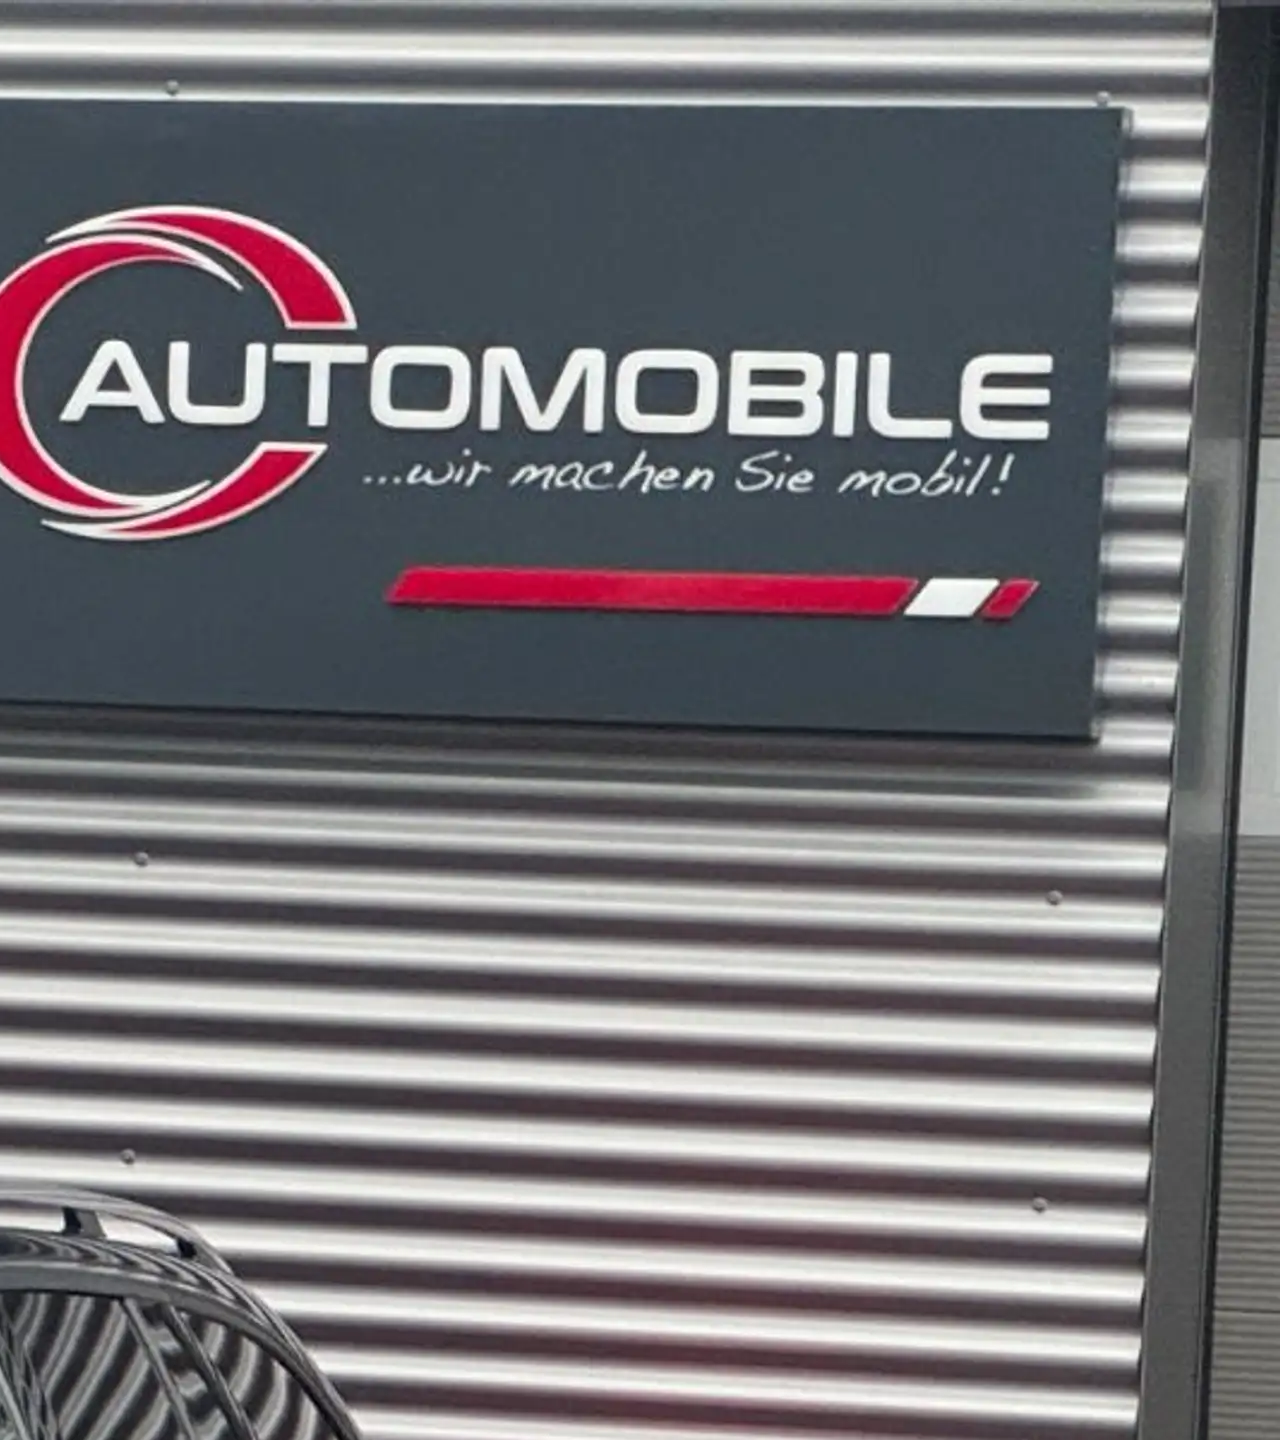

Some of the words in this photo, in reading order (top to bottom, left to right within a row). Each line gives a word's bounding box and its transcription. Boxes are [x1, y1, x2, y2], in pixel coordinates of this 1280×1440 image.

[59, 338, 1053, 442] AUTOMOBILE
[363, 447, 492, 487] ...wir
[508, 450, 717, 495] machen
[735, 450, 816, 494] Sie
[837, 450, 1016, 497] mobil!
